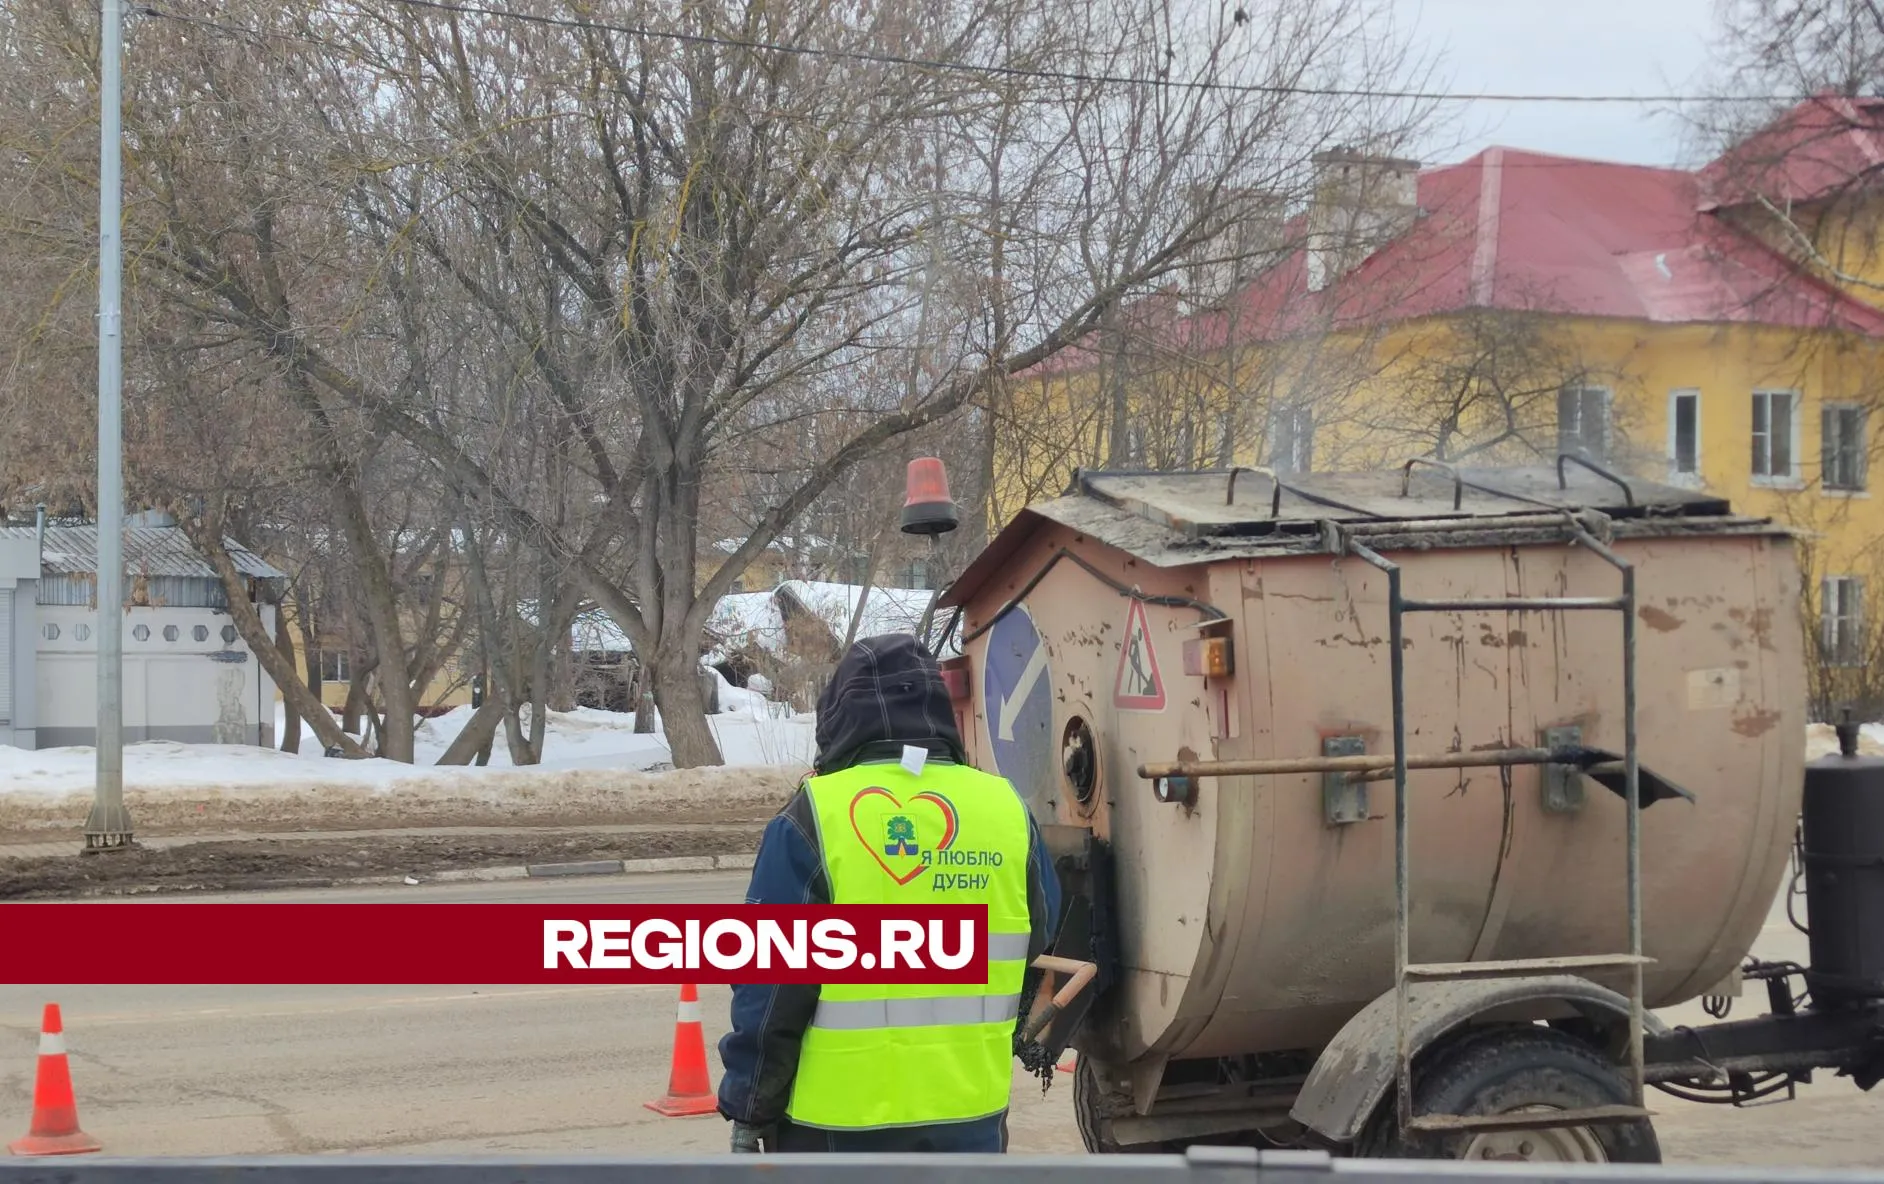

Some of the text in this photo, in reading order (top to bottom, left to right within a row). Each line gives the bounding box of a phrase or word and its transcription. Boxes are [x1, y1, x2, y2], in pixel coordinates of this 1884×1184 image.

[921, 851, 1003, 867] Я ЛЮБЛЮ
[932, 873, 990, 892] ДУБНУ
